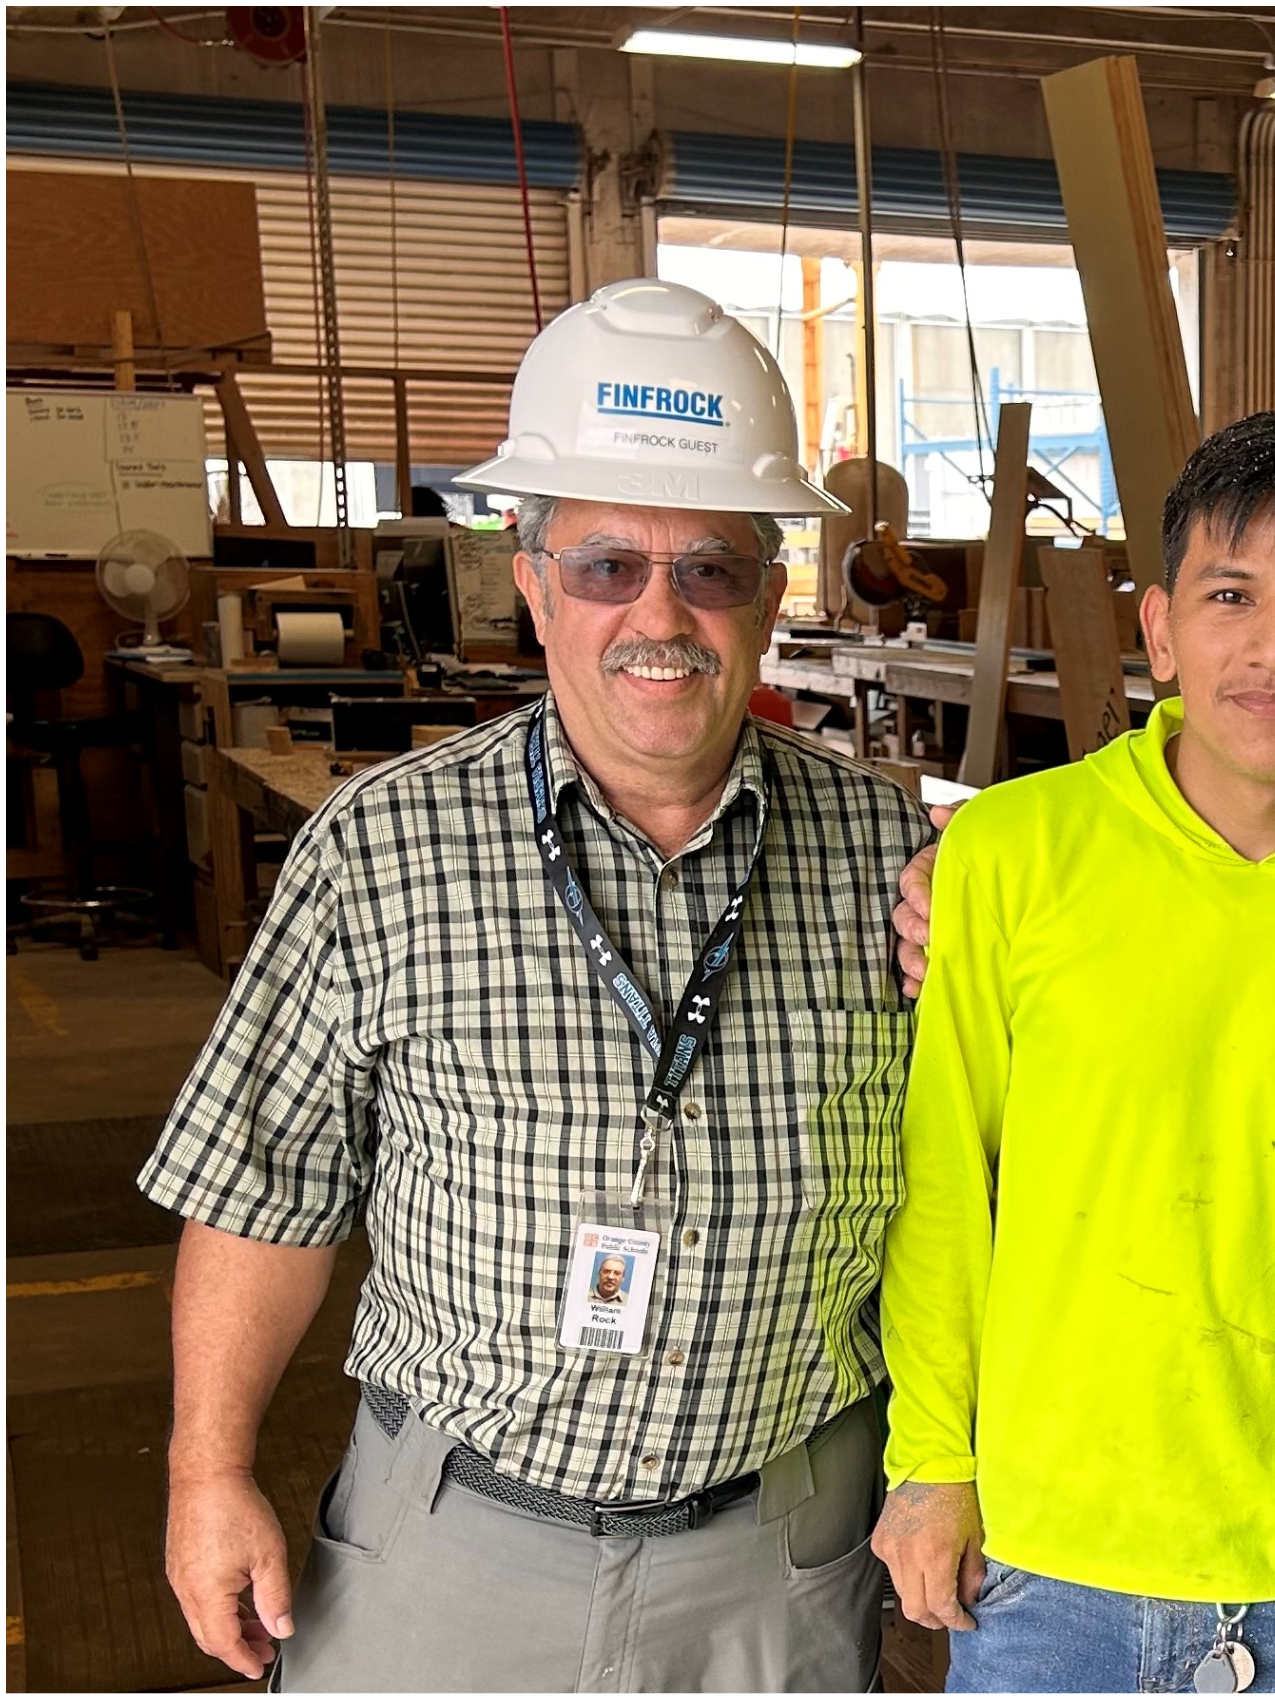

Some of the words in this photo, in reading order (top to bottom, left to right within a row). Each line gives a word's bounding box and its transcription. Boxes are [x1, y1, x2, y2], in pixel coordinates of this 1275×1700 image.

[597, 382, 723, 419] FINFROCK
[614, 432, 676, 449] FINFROCK
[679, 438, 718, 453] GUEST
[612, 972, 652, 1031] TITANS
[664, 1034, 697, 1088] TITANS
[602, 1235, 627, 1244] Orange
[628, 1239, 650, 1248] County
[592, 1314, 616, 1324] Rock
